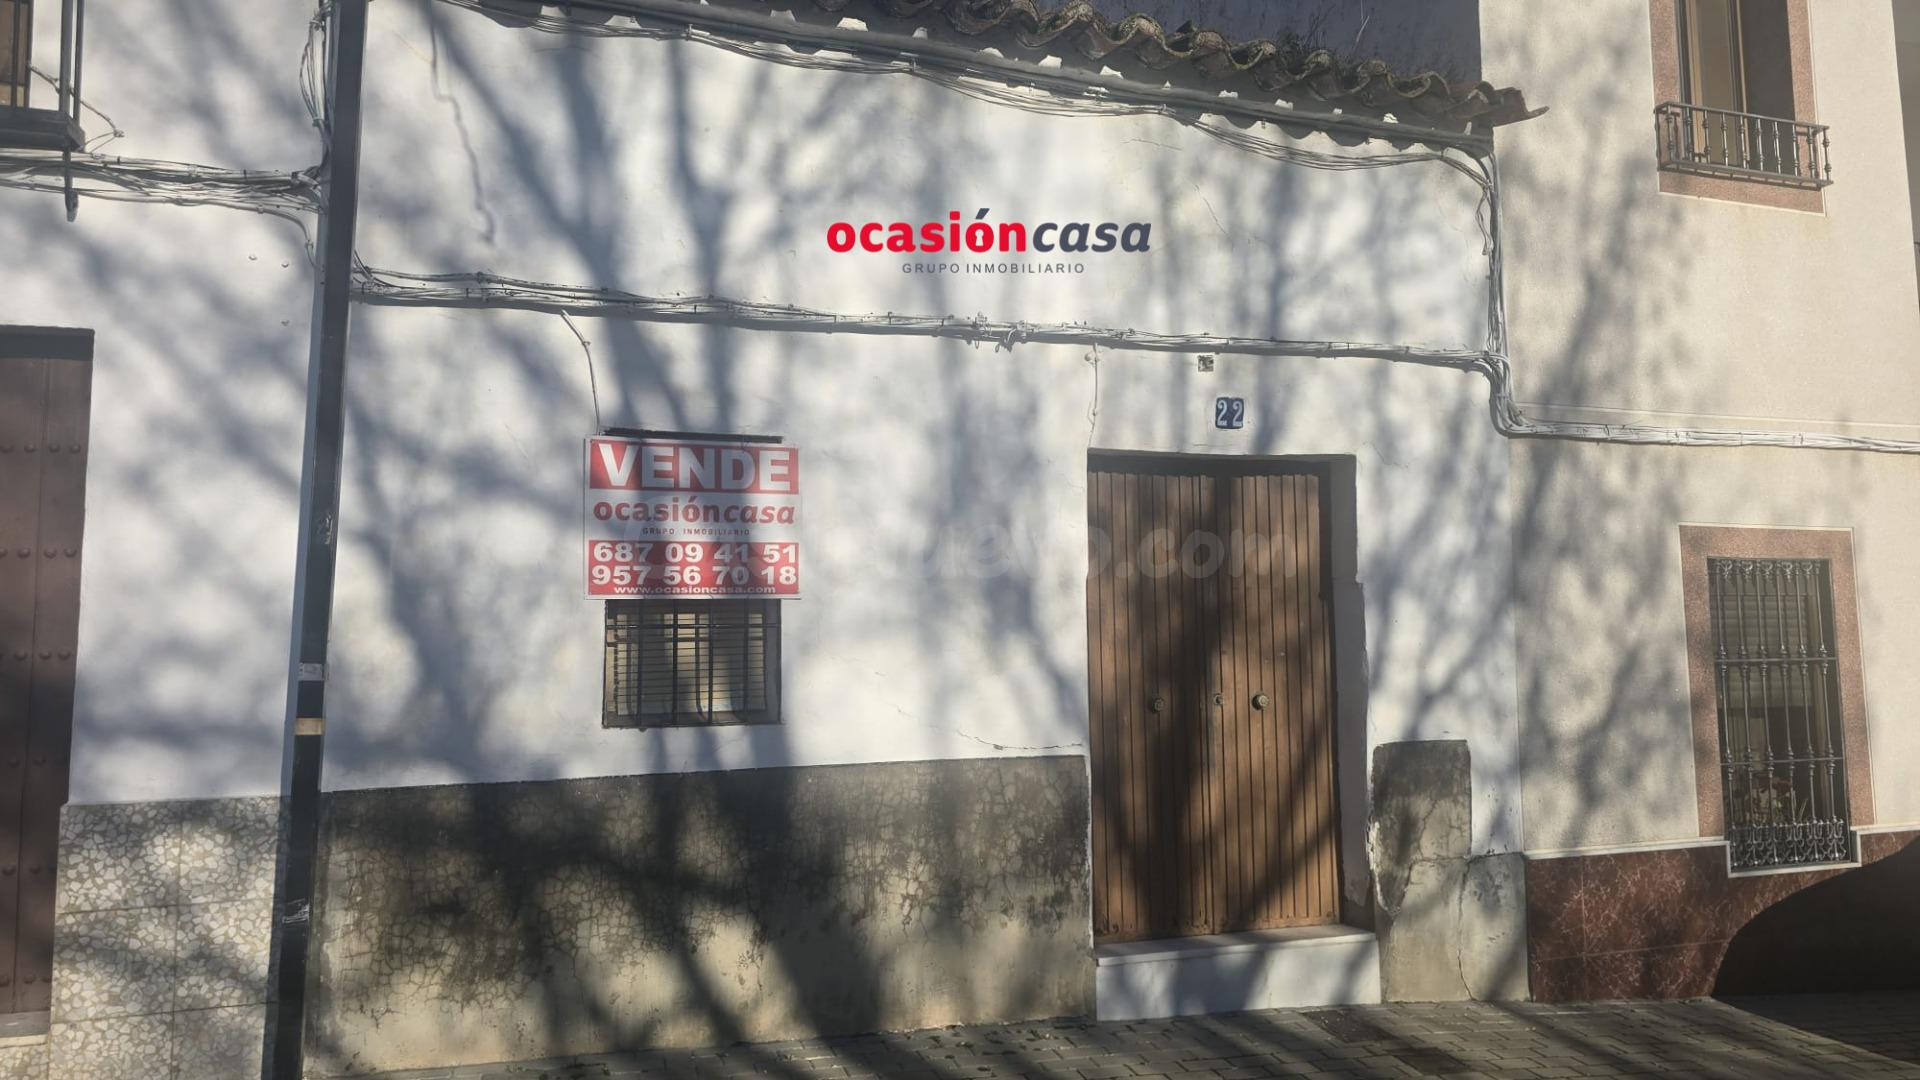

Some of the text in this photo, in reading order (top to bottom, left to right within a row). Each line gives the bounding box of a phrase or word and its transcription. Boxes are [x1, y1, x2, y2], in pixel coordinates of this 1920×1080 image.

[1216, 400, 1243, 427] 22
[598, 443, 791, 491] VENDE
[593, 496, 796, 525] ocasióncasa
[642, 528, 751, 537] GRUPO INMOBILIARIO
[593, 543, 797, 564] 687 09 41 51
[591, 565, 797, 586] 957 56 70 18
[613, 586, 777, 595] www.ocasioncasa.com
